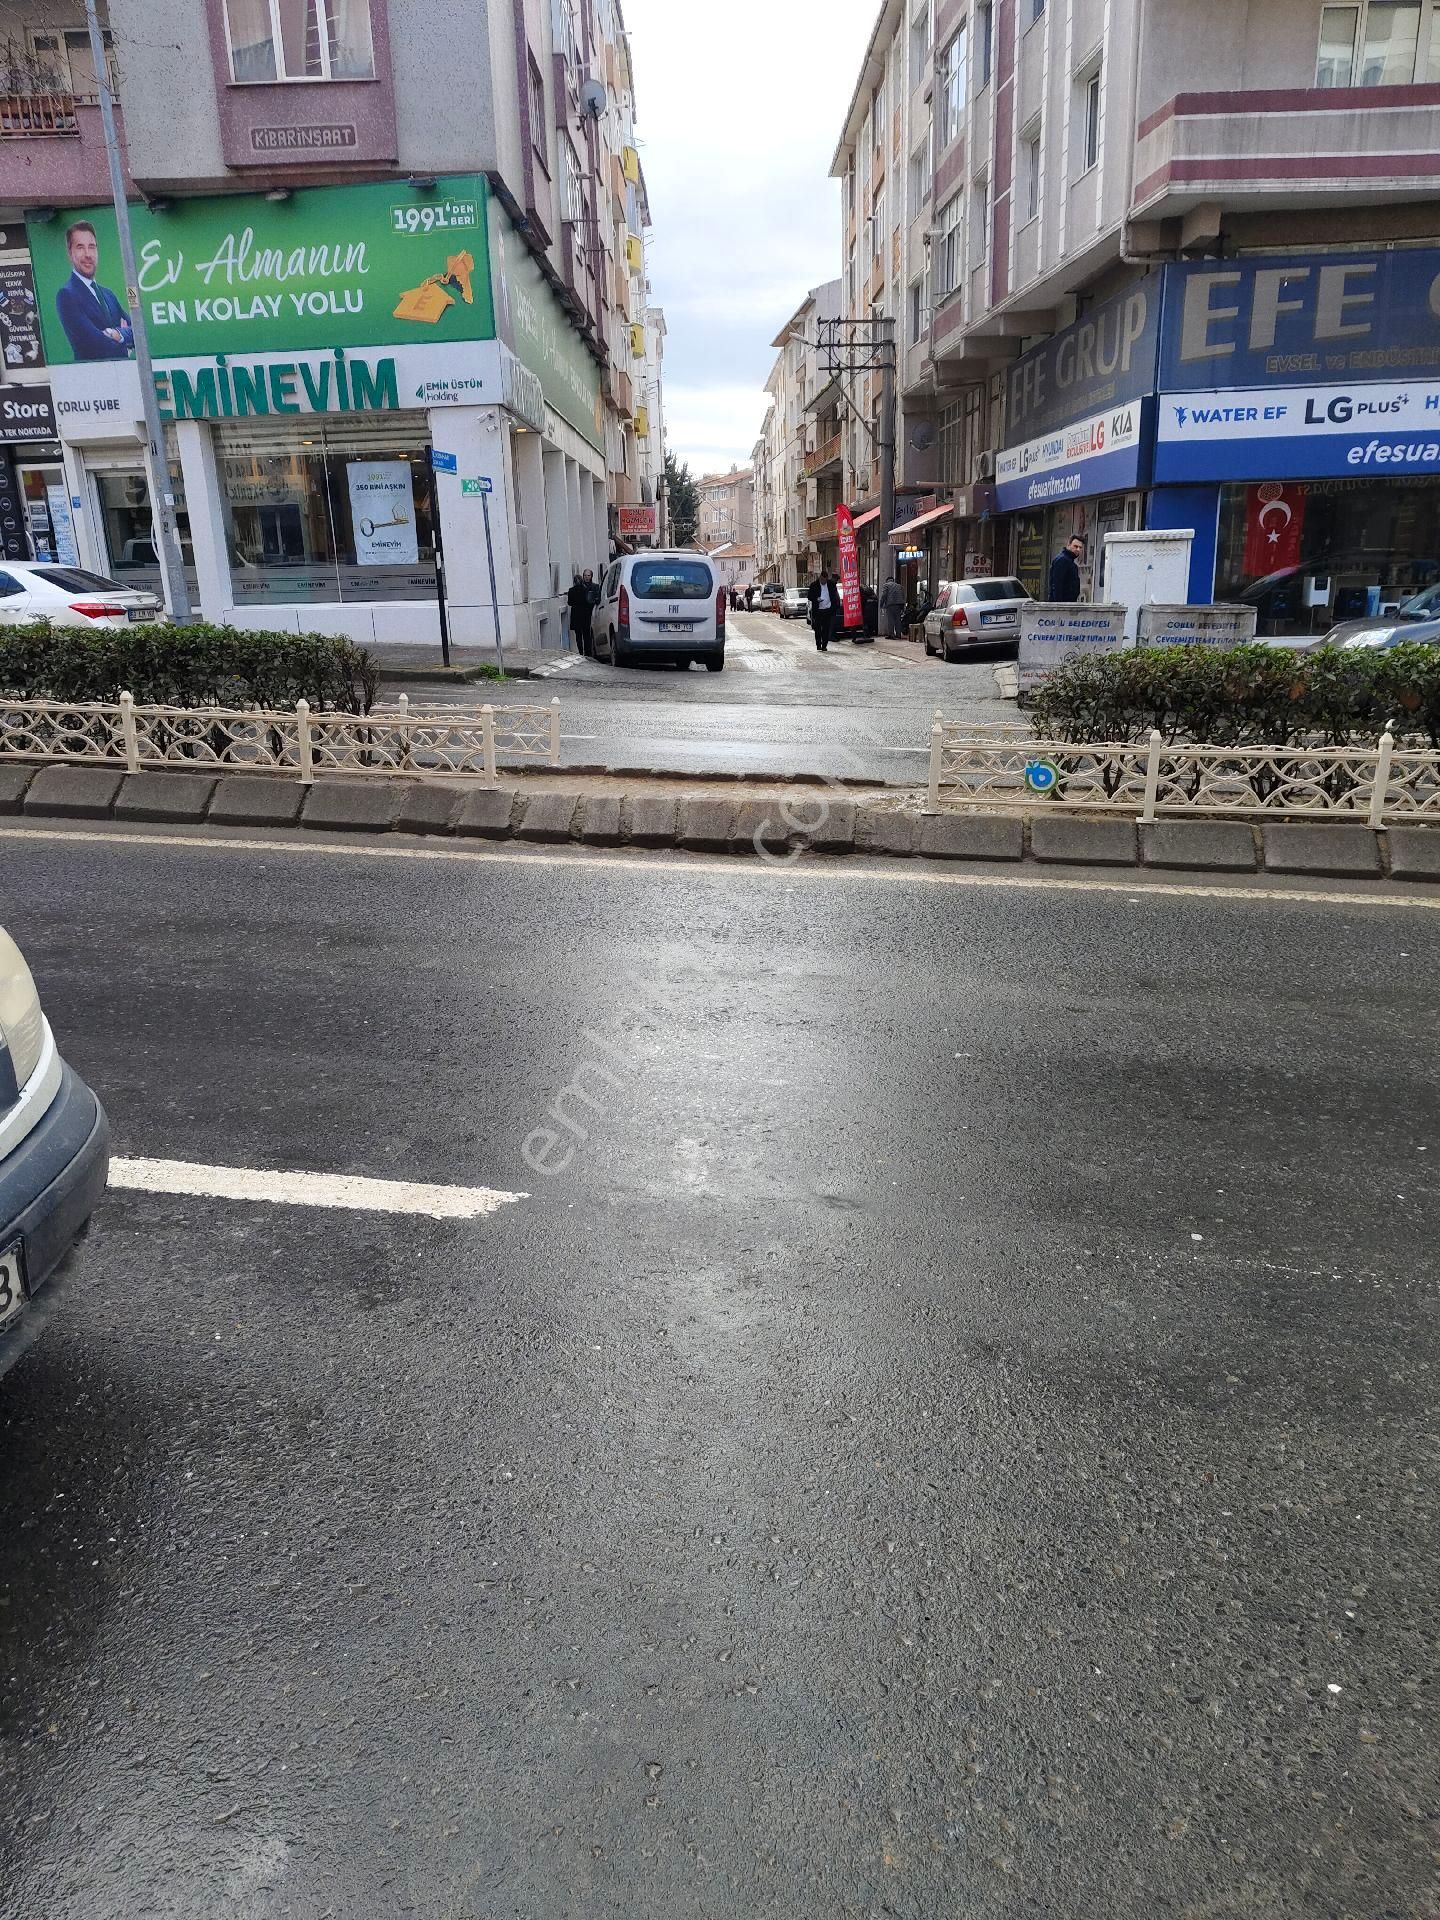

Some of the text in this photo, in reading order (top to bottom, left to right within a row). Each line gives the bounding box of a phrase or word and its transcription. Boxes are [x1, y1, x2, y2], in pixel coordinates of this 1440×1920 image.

[450, 214, 475, 225] BERİ
[137, 227, 370, 291] Ev Almanın
[151, 288, 364, 324] EN KOLAY YOLU
[1180, 263, 1377, 361] EFE
[1010, 351, 1047, 428] EFE
[1056, 292, 1147, 389] GRUP
[1266, 353, 1321, 373] EVSEL
[152, 346, 399, 419] EMİNEVİM
[426, 378, 483, 391] EMİN ÜSTÜN
[426, 391, 459, 402] Holding
[3, 401, 49, 418] Store
[57, 399, 121, 415] ÇORLU ŞUBE
[1191, 406, 1258, 424] WATER
[1263, 406, 1288, 420] EF
[1304, 396, 1353, 425] LG
[5, 429, 17, 437] TEK
[17, 427, 52, 436] NOKTADA
[1019, 448, 1029, 473] LG
[1091, 420, 1105, 451] LG
[1111, 411, 1133, 438] KIA
[384, 483, 406, 492] AŞKIN
